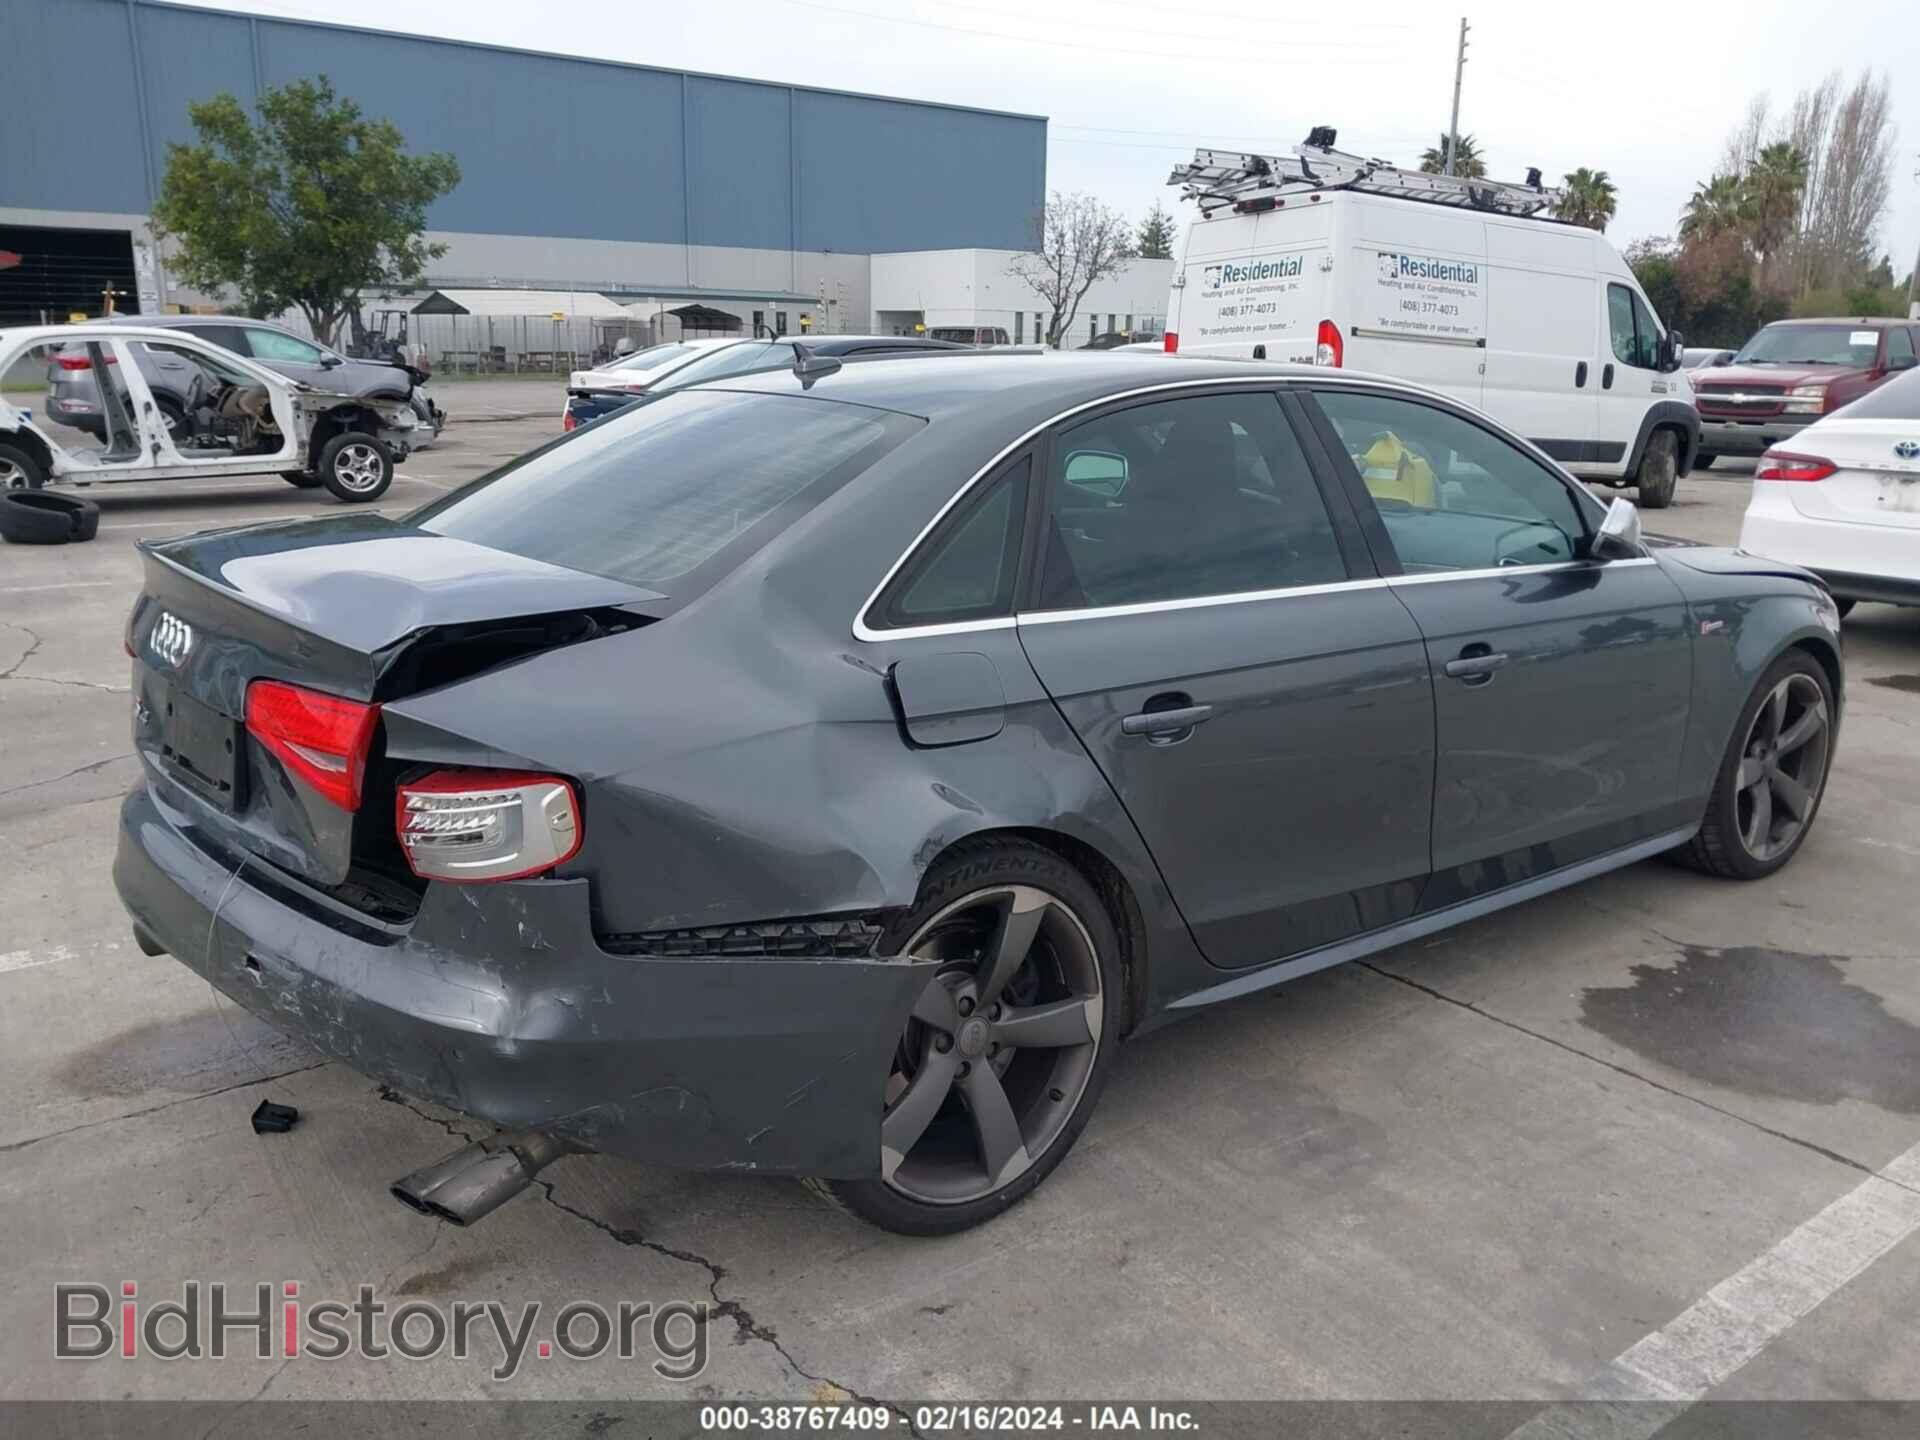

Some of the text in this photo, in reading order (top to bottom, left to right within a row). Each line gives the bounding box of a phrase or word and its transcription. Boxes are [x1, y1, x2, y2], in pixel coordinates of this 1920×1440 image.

[1222, 255, 1303, 284] Residential
[1400, 255, 1478, 284] Residential
[1378, 279, 1402, 290] Heating
[1224, 288, 1236, 297] and
[1218, 302, 1276, 319] (408) 377-4073
[1400, 299, 1459, 316] (408) 377-4073
[1209, 324, 1245, 335] comfortable
[1252, 323, 1267, 333] your
[1390, 320, 1428, 330] comfortable
[1437, 324, 1452, 333] your
